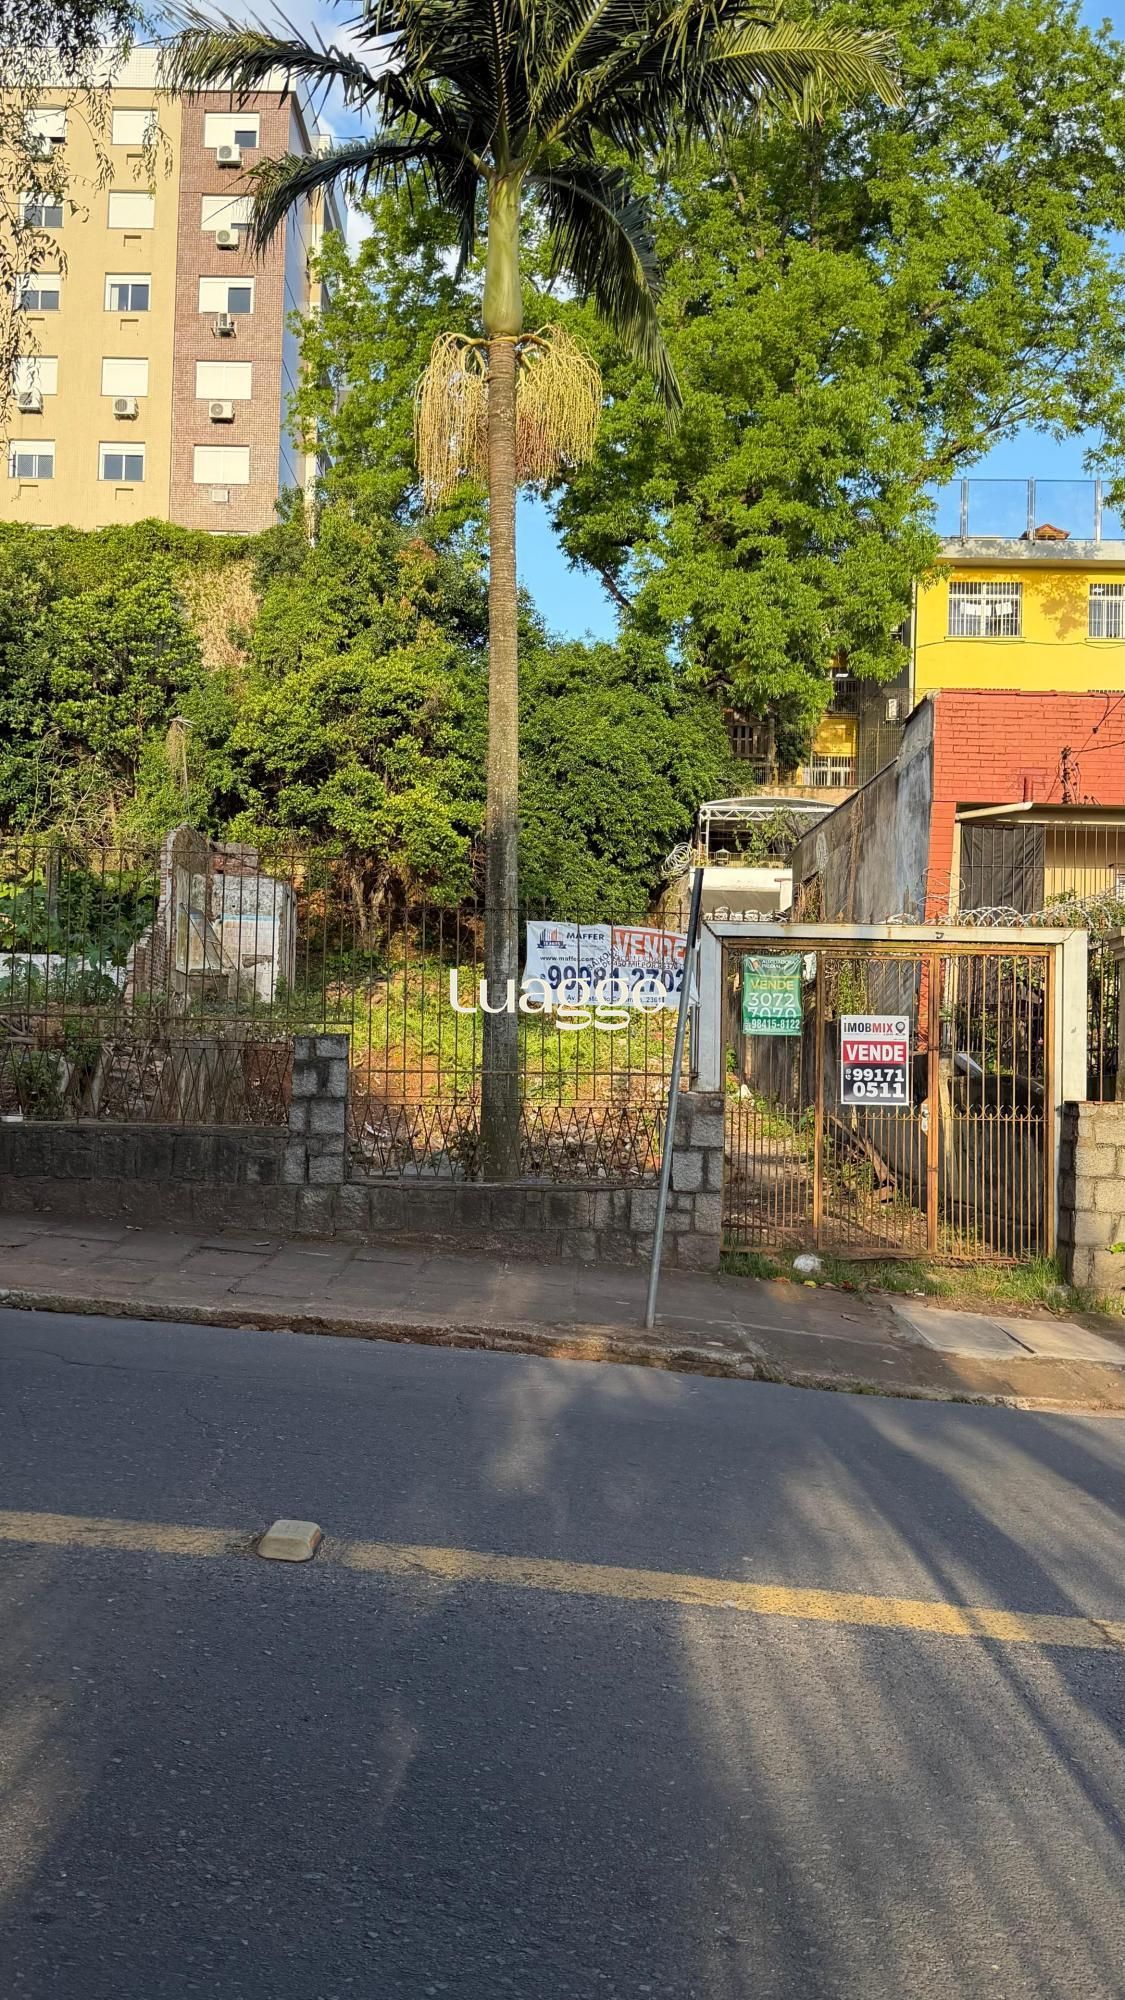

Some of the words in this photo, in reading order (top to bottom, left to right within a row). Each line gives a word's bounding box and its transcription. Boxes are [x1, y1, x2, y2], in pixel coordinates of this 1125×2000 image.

[566, 932, 605, 941] MAFFER
[615, 931, 687, 962] VENDE
[540, 954, 594, 963] www.maffe.com
[751, 979, 795, 991] VENDE
[748, 992, 796, 1008] 3072
[843, 1022, 893, 1034] IMOBMIX
[845, 1043, 905, 1063] VENDE
[852, 1068, 905, 1082] 99171
[852, 1081, 905, 1098] 0511
